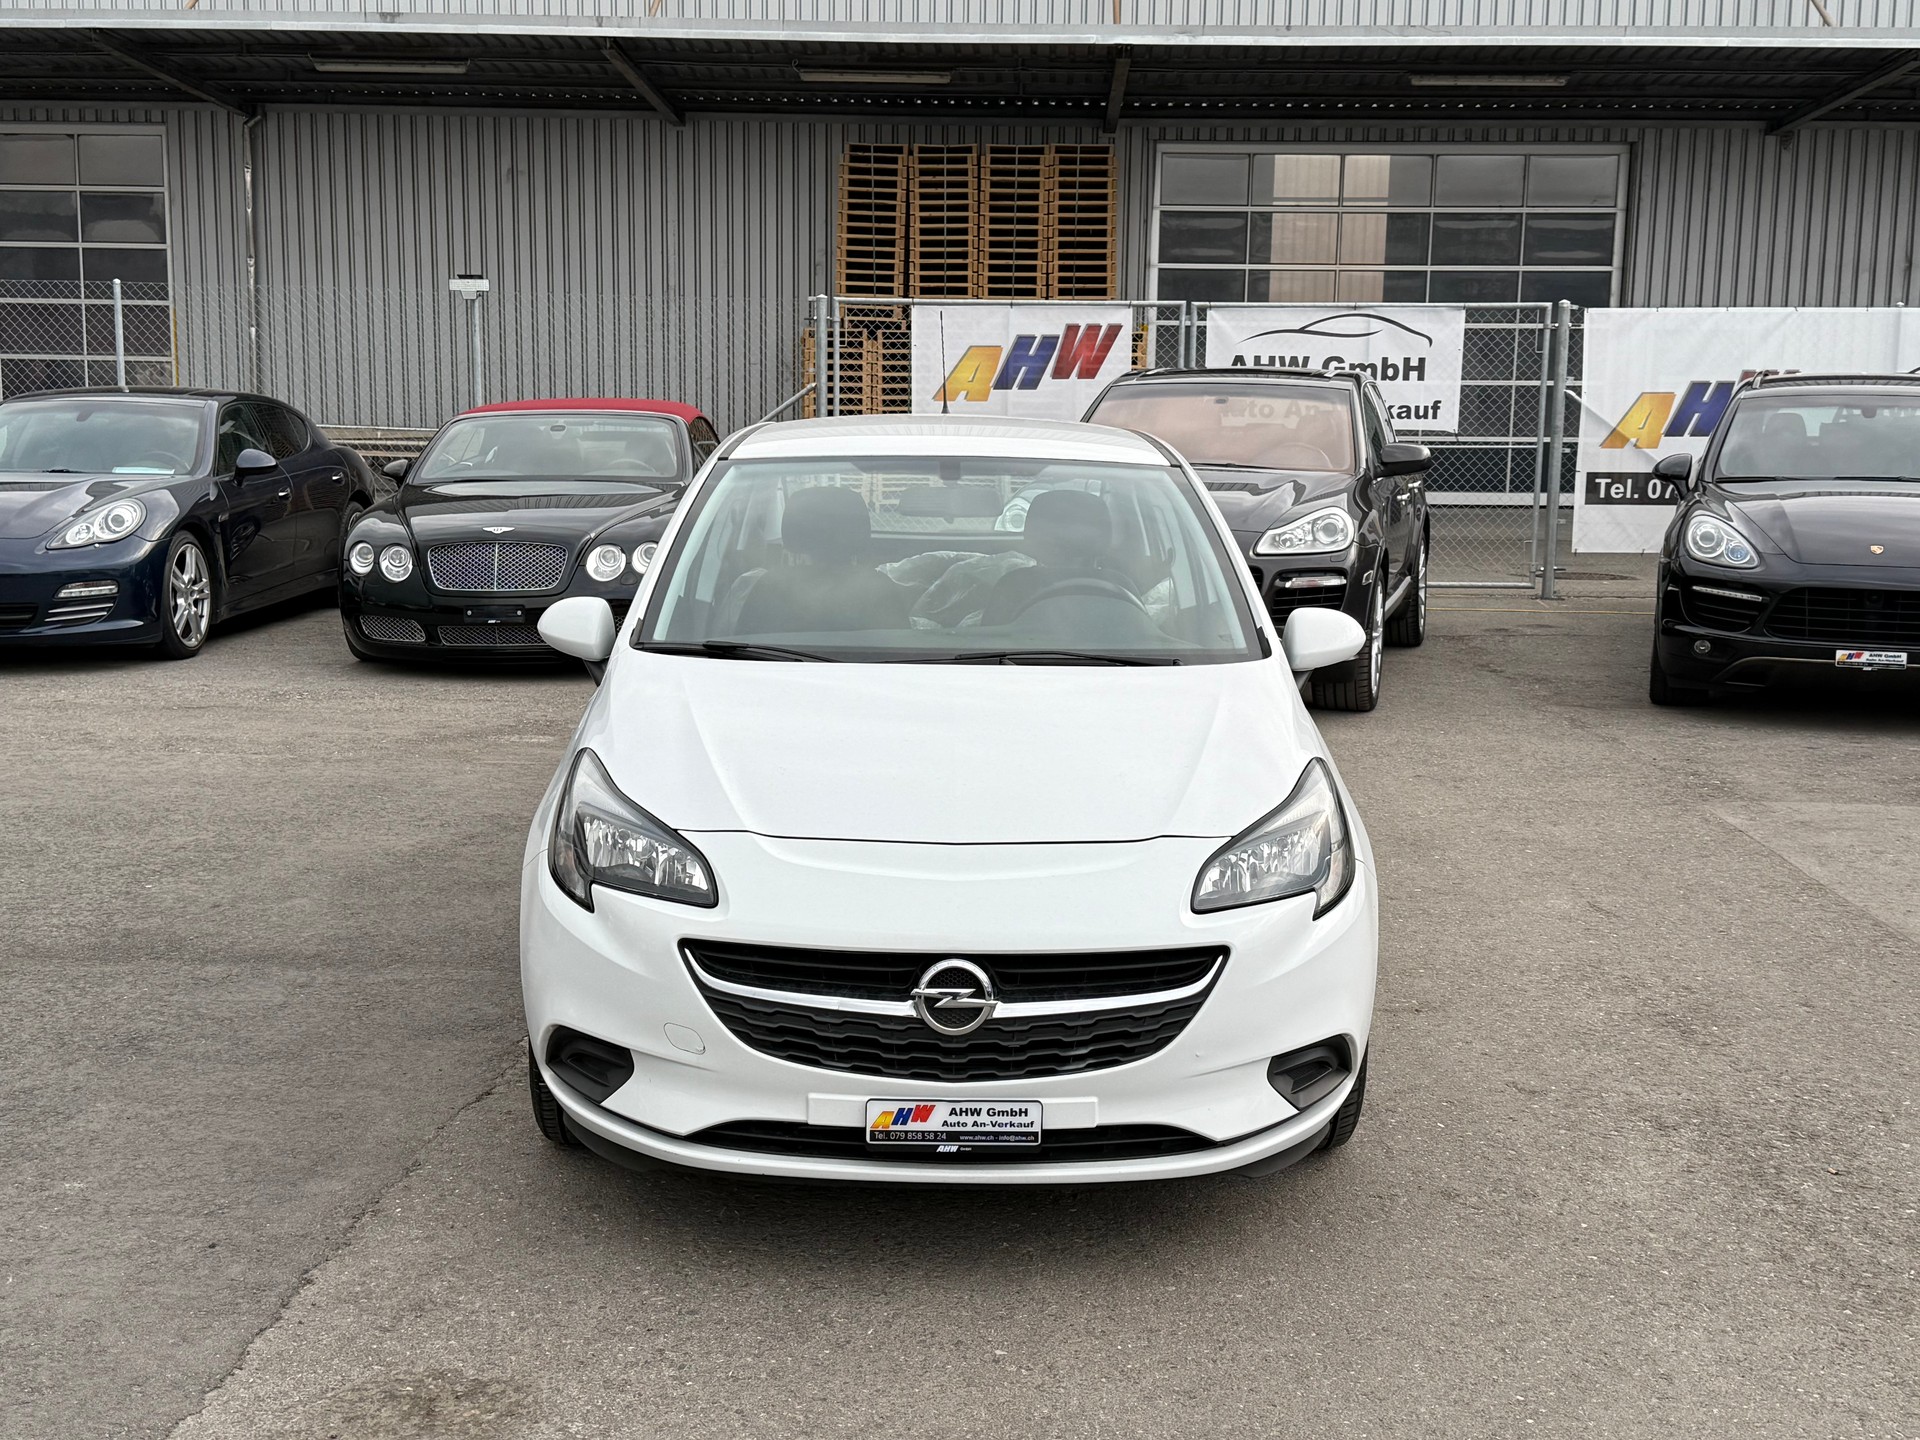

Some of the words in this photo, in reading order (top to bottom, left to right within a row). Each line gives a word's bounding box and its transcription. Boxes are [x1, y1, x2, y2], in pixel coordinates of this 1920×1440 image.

[932, 323, 1123, 402] AHW
[1321, 355, 1426, 381] GmbH
[1599, 369, 1802, 449] AH
[1595, 478, 1639, 499] Tel.
[1647, 478, 1678, 499] 07
[870, 1104, 936, 1129] AHW
[948, 1107, 982, 1117] AHW
[986, 1107, 1028, 1117] GmbH
[941, 1120, 968, 1128] Auto
[972, 1120, 1035, 1129] An-Verkauf
[874, 1132, 888, 1140] Tel.
[890, 1132, 905, 1140] 079
[907, 1132, 923, 1140] 858
[924, 1132, 935, 1140] 58
[936, 1132, 947, 1140] 24
[999, 1134, 1035, 1142] info@ahw.ch
[936, 1145, 958, 1153] AHW
